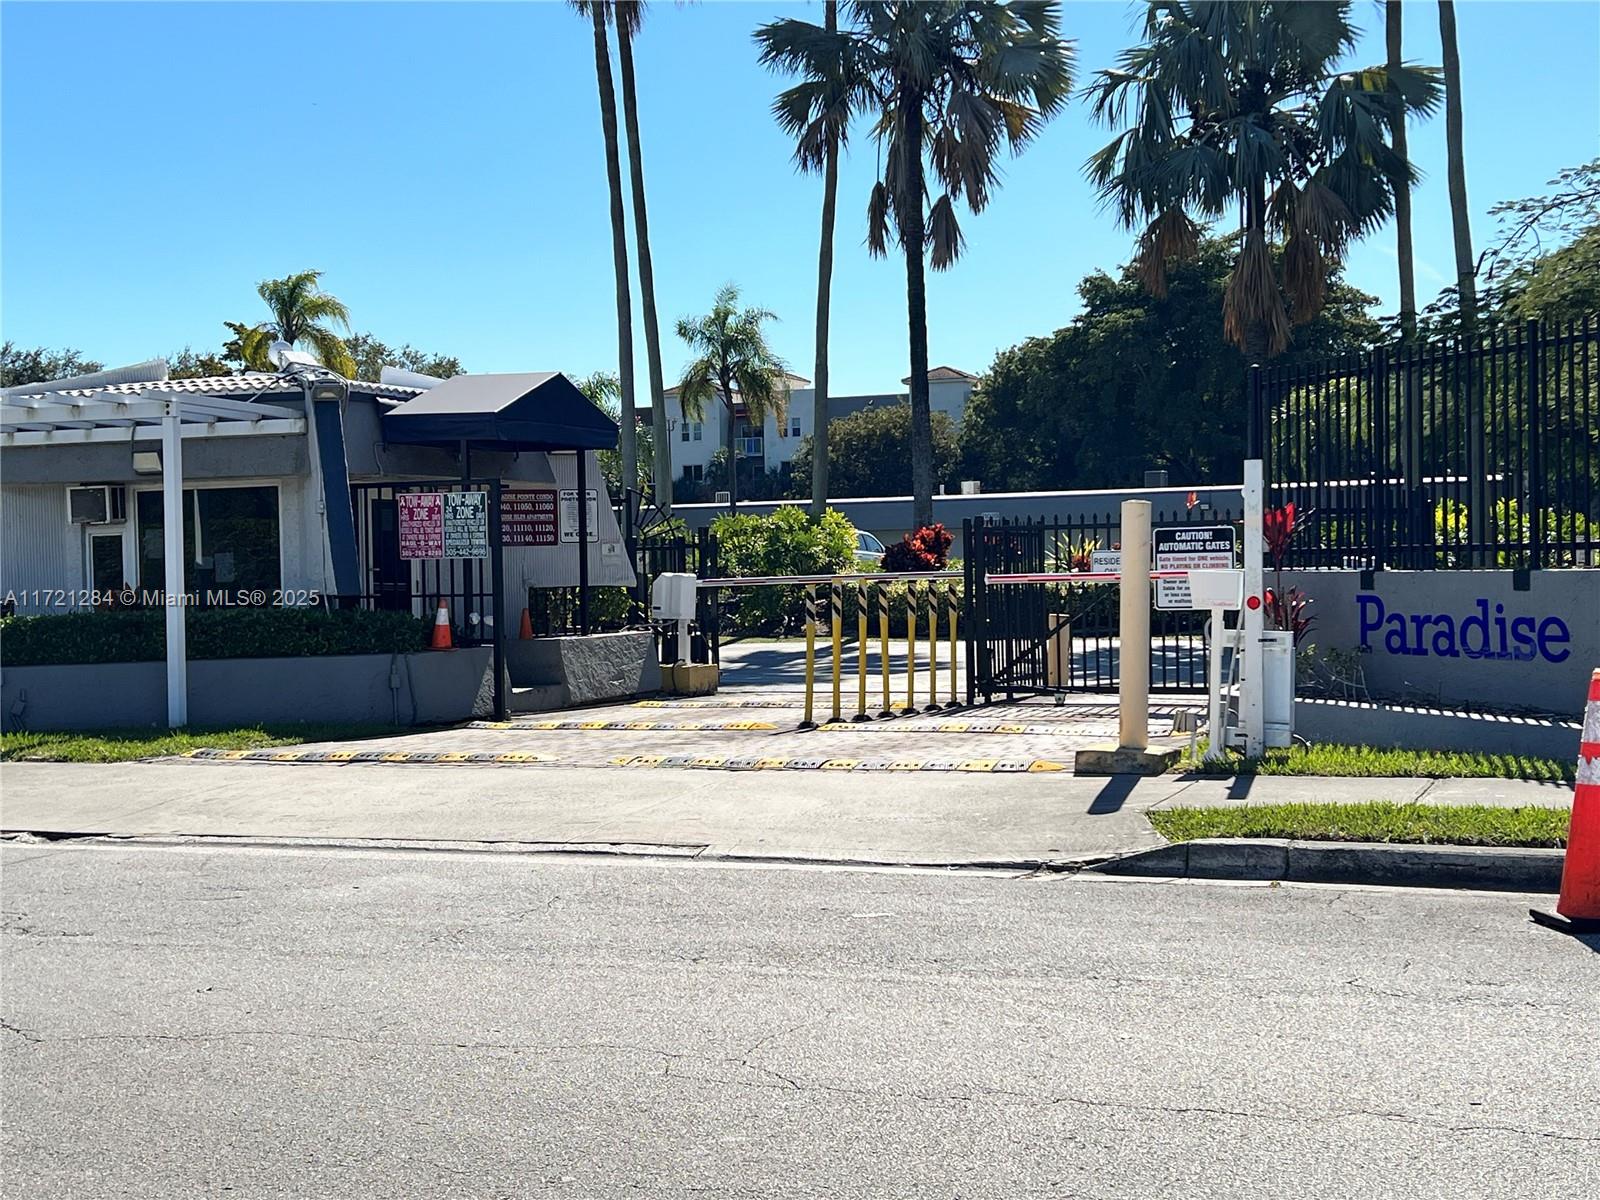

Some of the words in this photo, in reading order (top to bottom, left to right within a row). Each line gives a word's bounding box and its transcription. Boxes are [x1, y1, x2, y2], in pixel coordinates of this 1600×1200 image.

[406, 496, 434, 508] TOW-AWAY
[447, 494, 482, 506] TOW-AWAY
[413, 508, 428, 520] ZONE
[456, 507, 474, 518] ZONE
[1175, 531, 1213, 540] CAUTION!
[1158, 542, 1204, 551] AUTOMATIC
[1206, 541, 1231, 550] GATES
[1356, 595, 1570, 663] Paradise
